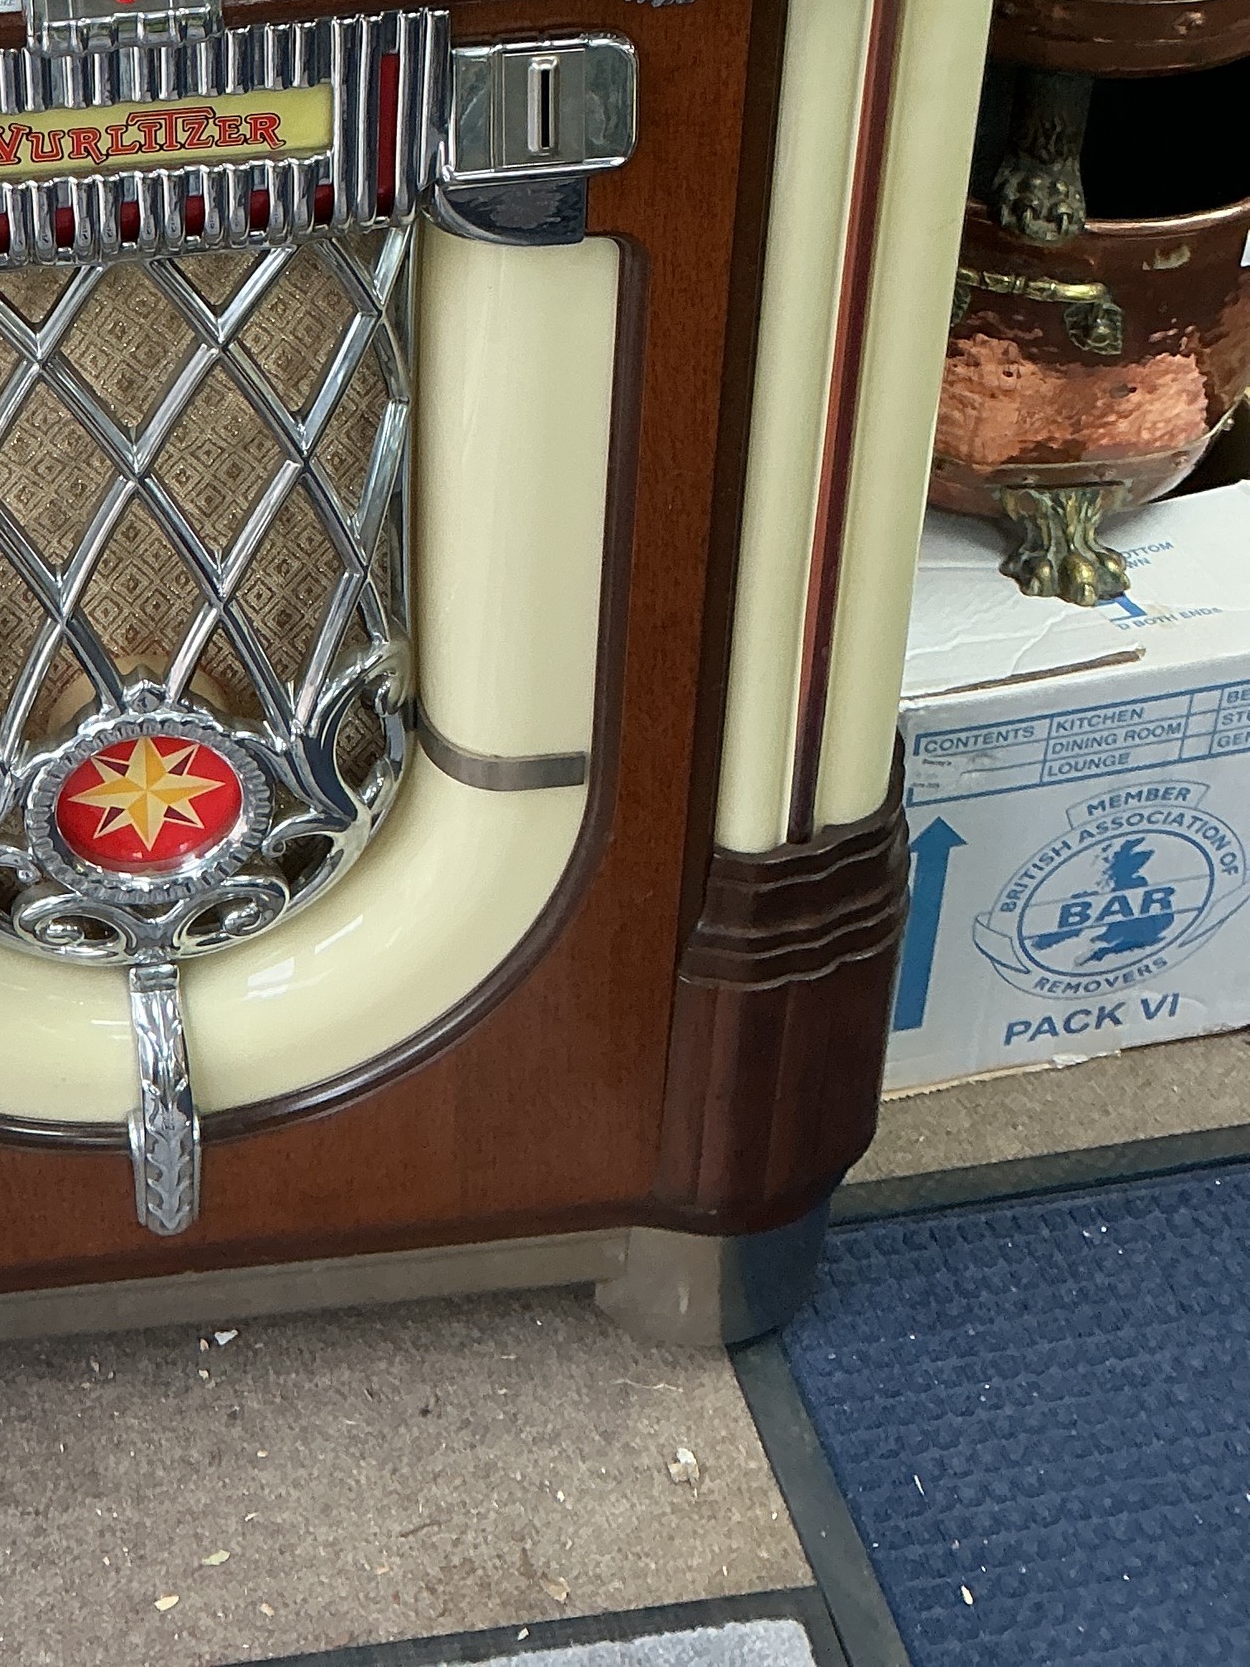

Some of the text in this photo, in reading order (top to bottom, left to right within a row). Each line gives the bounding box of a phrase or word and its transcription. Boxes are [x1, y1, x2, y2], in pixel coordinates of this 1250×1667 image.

[1055, 707, 1146, 732] KITCHEN
[924, 725, 1035, 754] CONTENTS
[1052, 721, 1181, 755] DINING ROOM
[1047, 752, 1130, 777] LOUNGE
[1087, 786, 1191, 817] MEMBER
[1000, 810, 1239, 913] BRITISH ASSOCIATION OF
[1058, 886, 1176, 929] BAR
[1032, 957, 1168, 994] REMOVERS
[1003, 992, 1180, 1046] PACK VI
